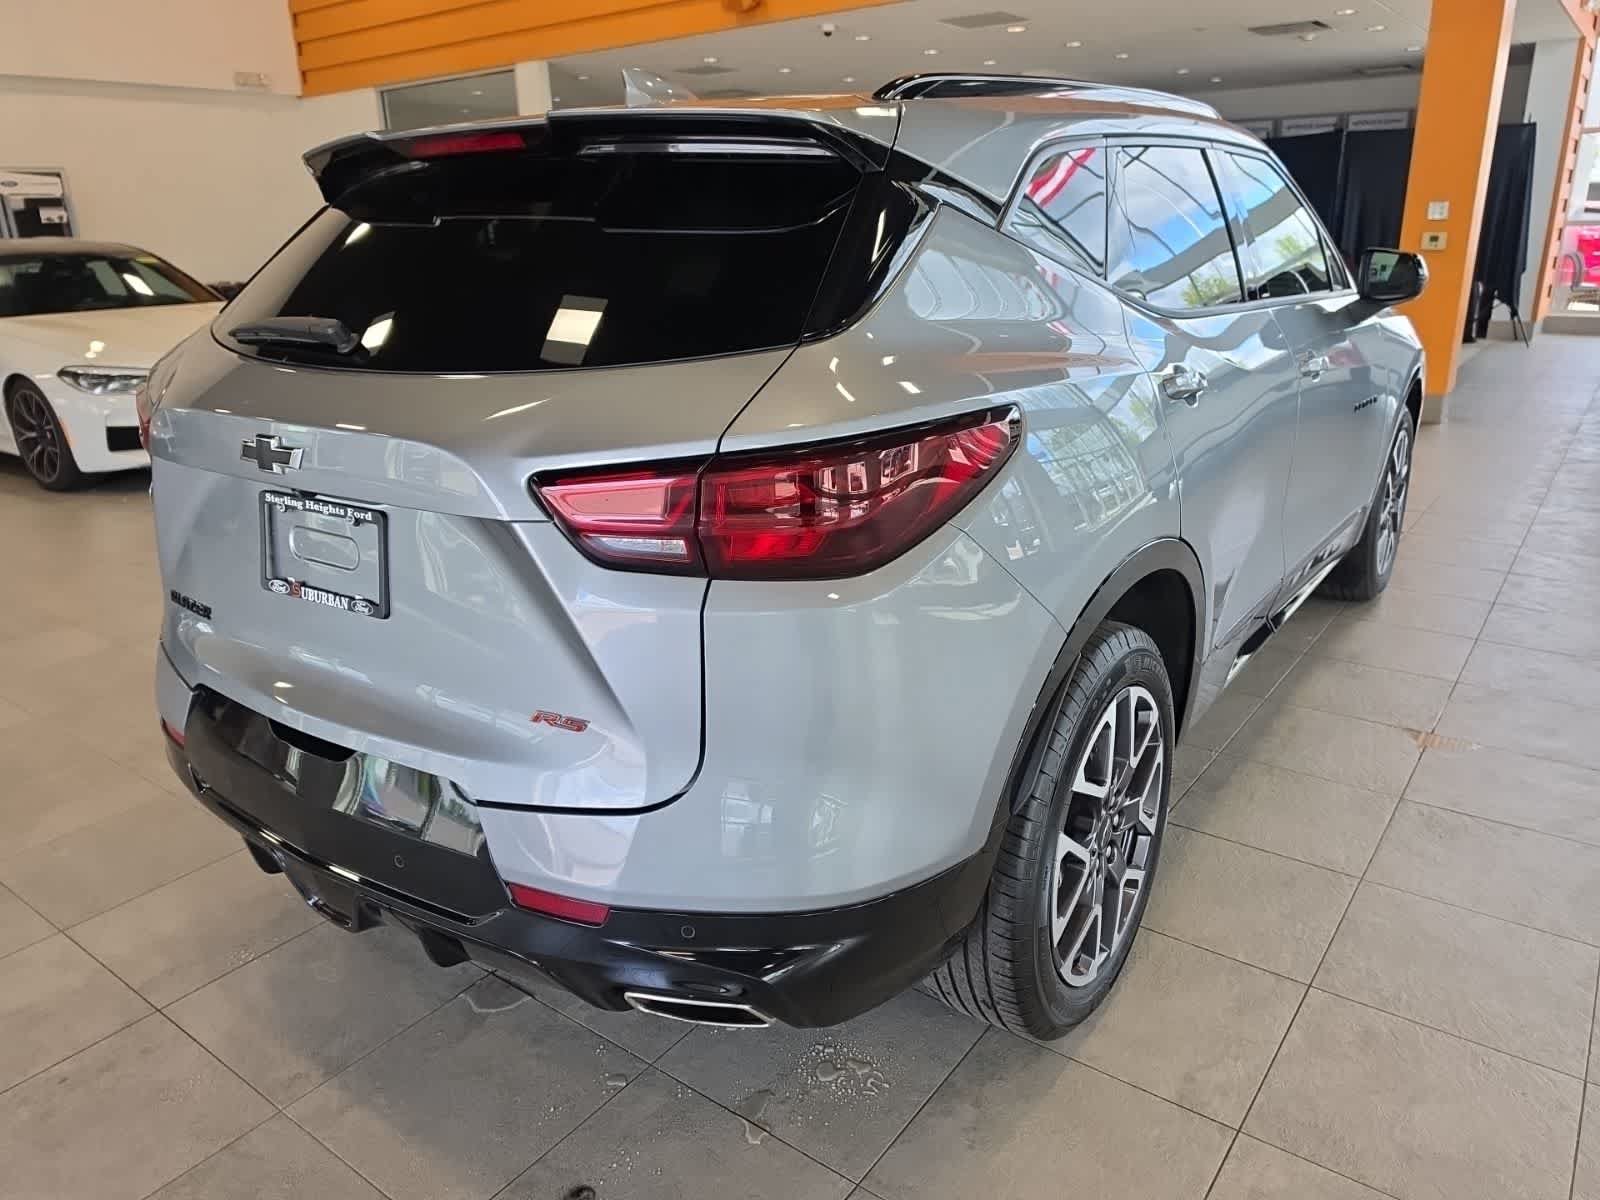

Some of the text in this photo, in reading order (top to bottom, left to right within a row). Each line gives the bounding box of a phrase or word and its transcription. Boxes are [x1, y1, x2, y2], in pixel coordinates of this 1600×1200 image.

[265, 493, 373, 521] Sterling Heights Ford
[293, 582, 349, 610] SUBURBAN
[529, 710, 591, 732] RS
